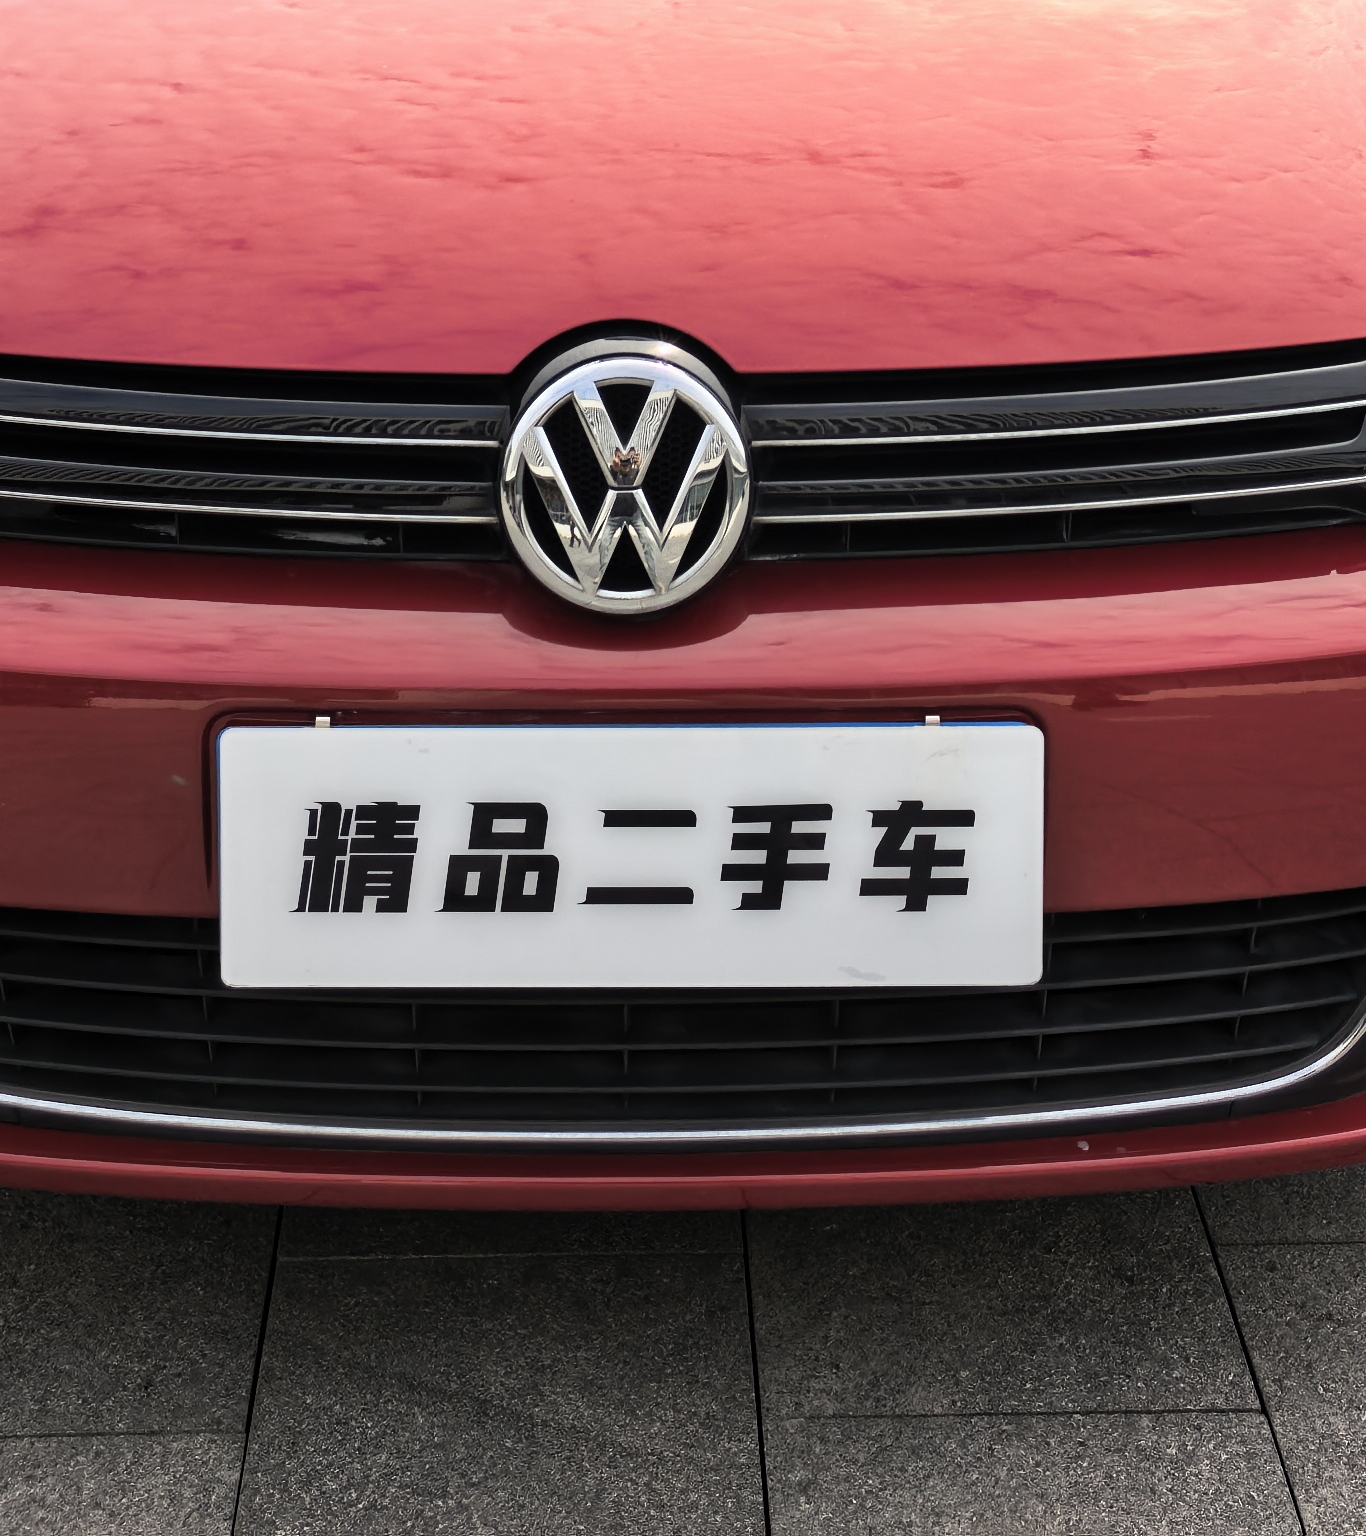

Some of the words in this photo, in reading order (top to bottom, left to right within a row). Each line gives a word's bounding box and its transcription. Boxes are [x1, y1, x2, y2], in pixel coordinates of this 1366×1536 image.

[502, 356, 750, 613] VW
[289, 800, 976, 914] 精品二手车
